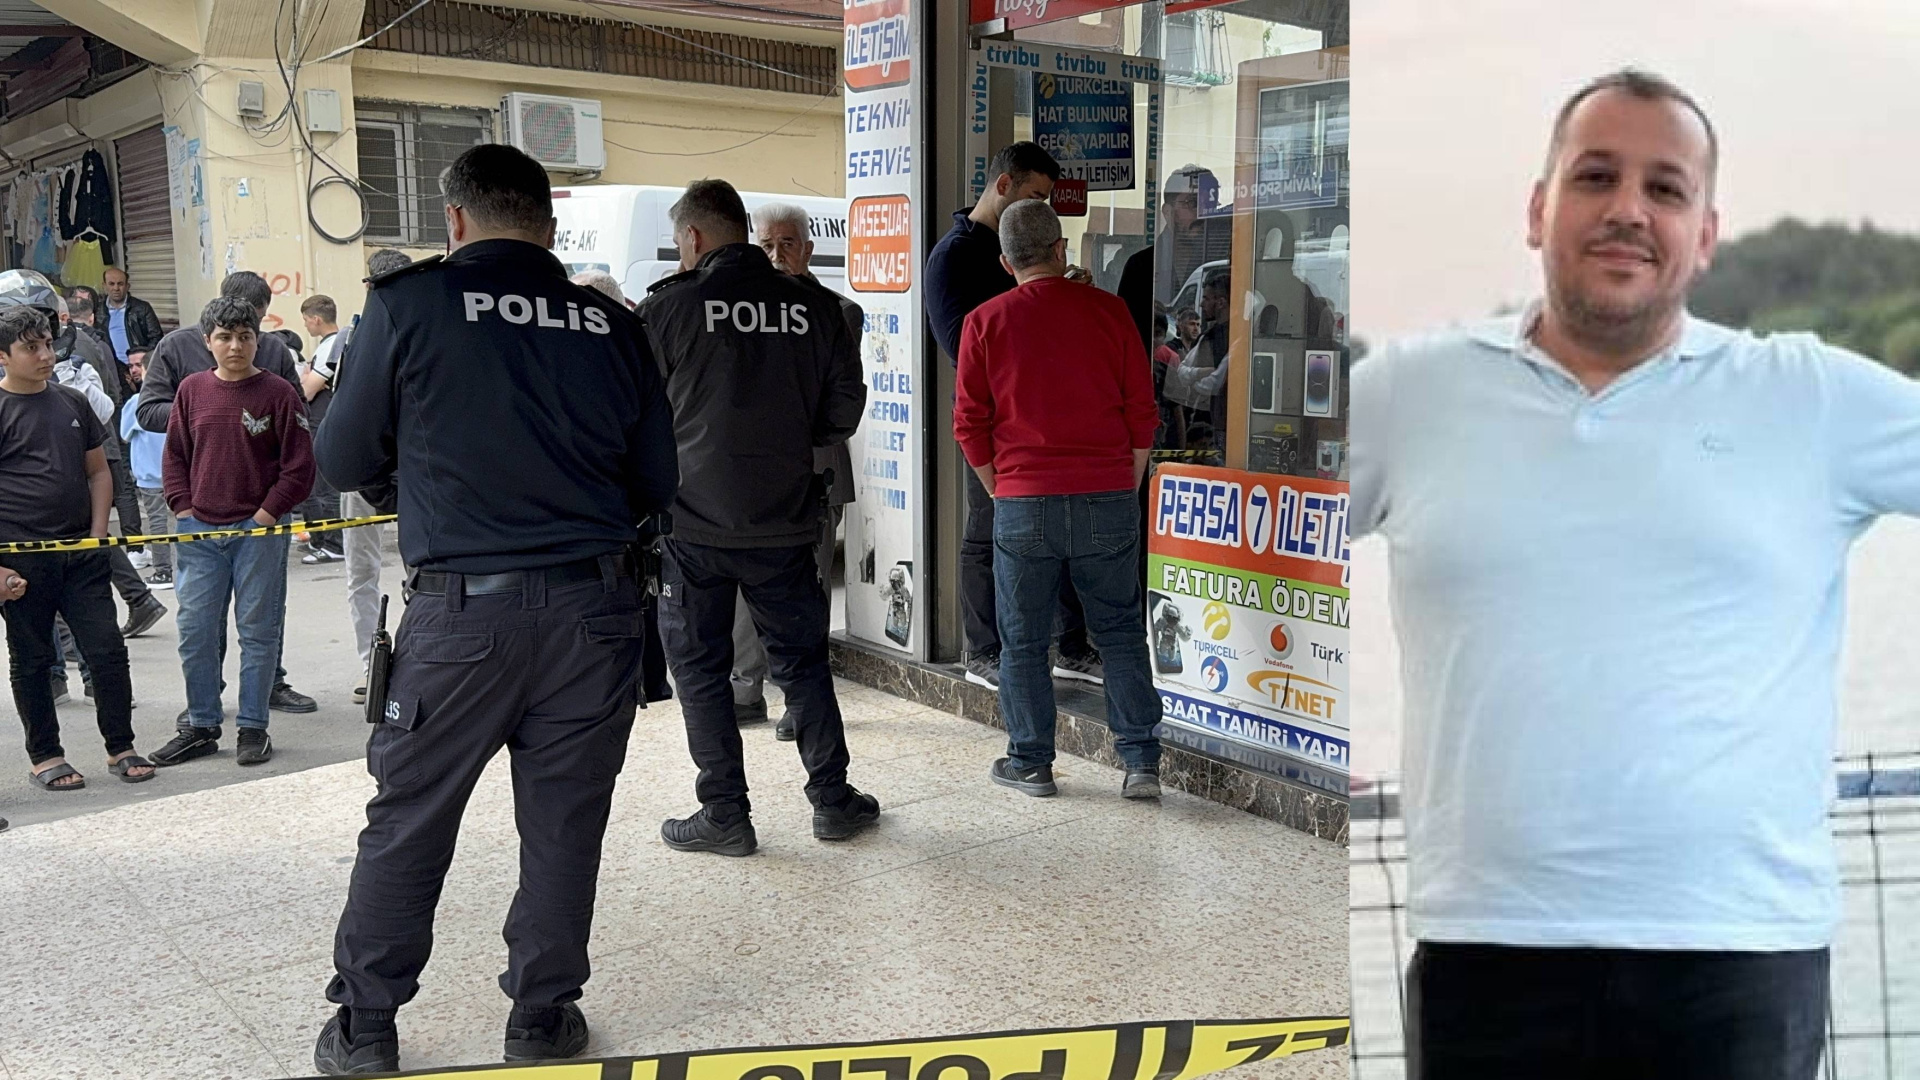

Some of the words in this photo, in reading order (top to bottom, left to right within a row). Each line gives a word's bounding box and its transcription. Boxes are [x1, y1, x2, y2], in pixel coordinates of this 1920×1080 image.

[987, 45, 1040, 67] tivibu
[1055, 52, 1106, 75] tivibu
[971, 61, 987, 134] tivibu
[1038, 106, 1065, 122] HAT
[1067, 107, 1128, 122] BULUNUR
[1082, 133, 1129, 149] YAPILIR
[852, 203, 909, 237] AKSESUAR
[853, 244, 909, 285] DÜNYASI
[1159, 479, 1239, 543] PERSA
[1251, 492, 1268, 548] 7
[1163, 563, 1263, 610] FATURA
[1193, 640, 1239, 661] TURKCELL
[1264, 657, 1294, 670] Vodafone
[1311, 642, 1343, 664] Türk
[1162, 695, 1211, 724] SAAT
[1268, 682, 1336, 719] TTNET
